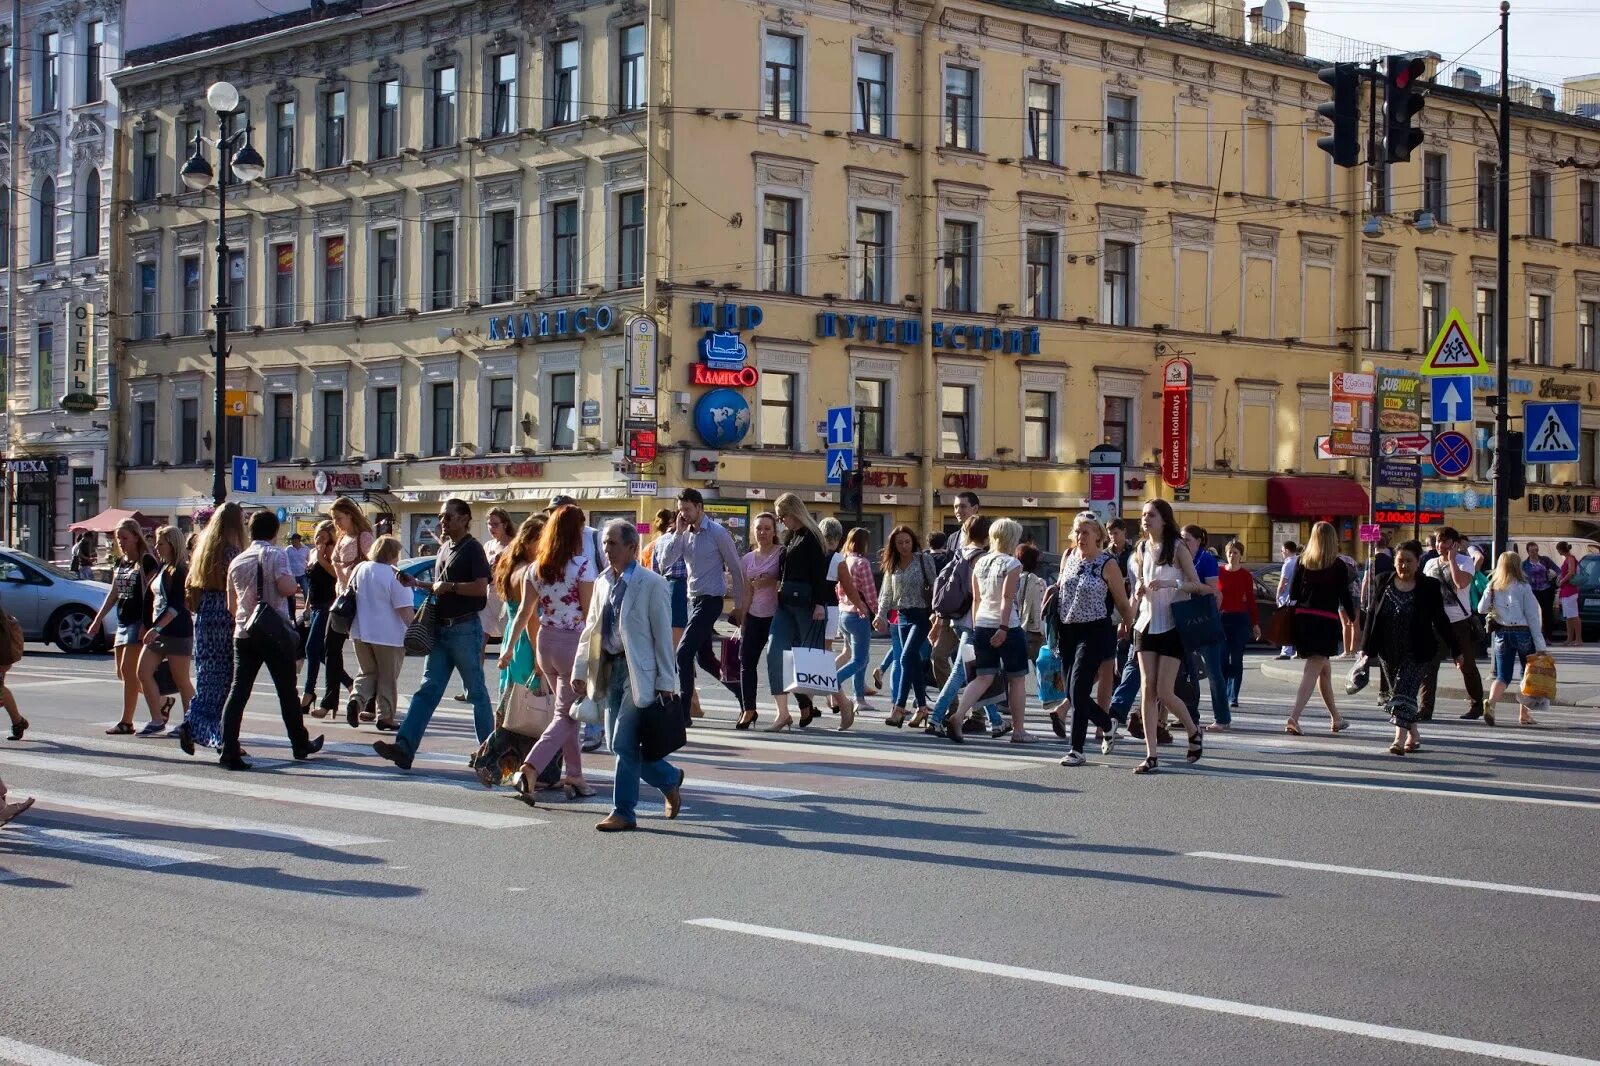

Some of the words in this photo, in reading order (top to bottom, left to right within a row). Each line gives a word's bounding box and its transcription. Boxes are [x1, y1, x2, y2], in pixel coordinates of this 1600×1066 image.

[488, 305, 613, 341] КАЛИПСО
[694, 302, 763, 330] МИР
[74, 306, 87, 389] ОТЕЛЬ
[1381, 378, 1420, 392] SUBWAY
[631, 482, 656, 490] НОТАРИУС
[1528, 494, 1586, 512] НОЖИ
[797, 673, 837, 688] DKNY
